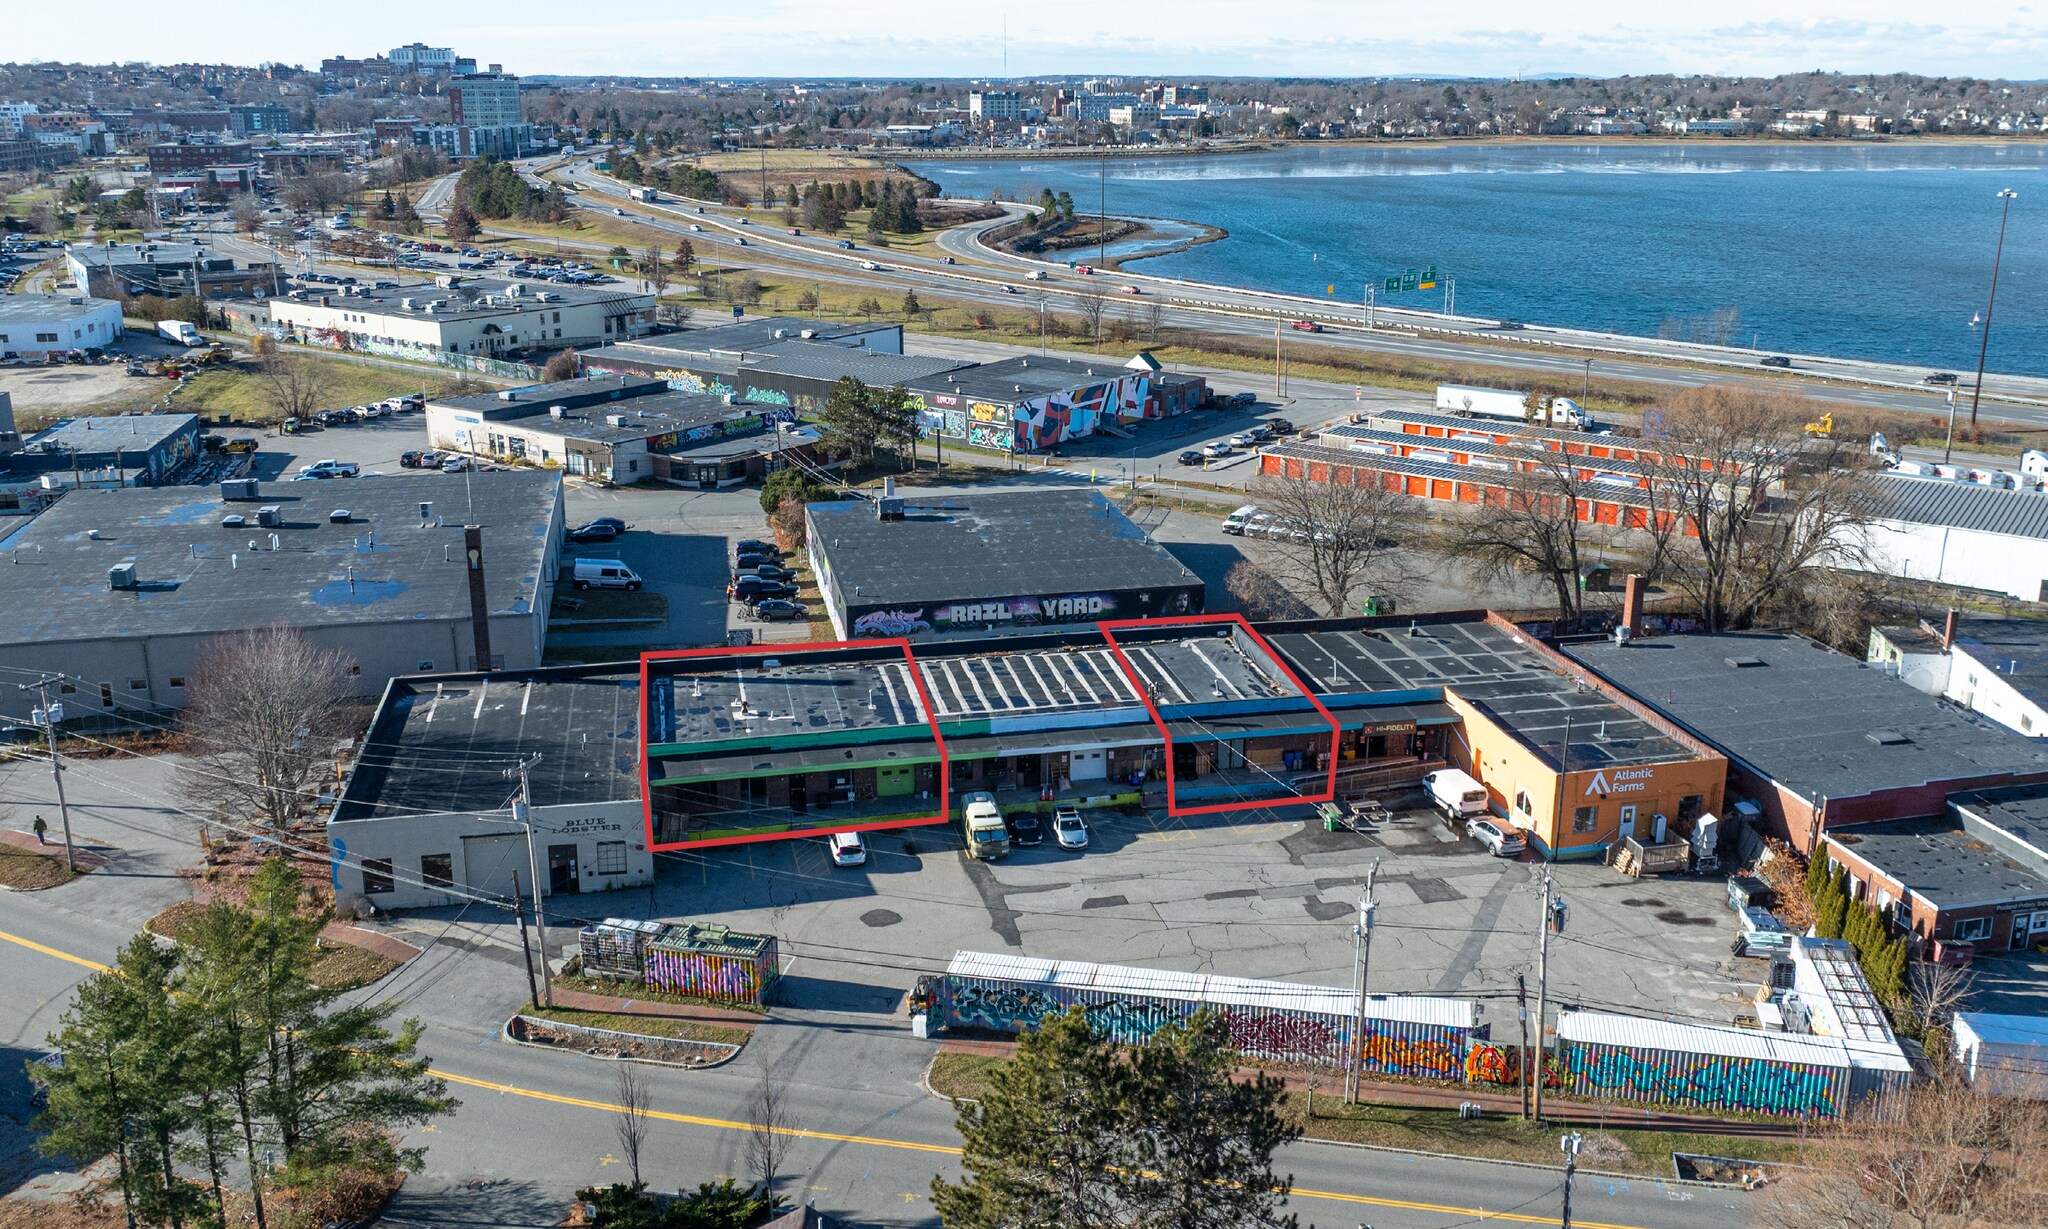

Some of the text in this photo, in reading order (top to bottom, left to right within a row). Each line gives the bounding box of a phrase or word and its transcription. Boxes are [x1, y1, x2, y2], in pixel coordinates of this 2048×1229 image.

[951, 602, 1013, 623] RAIL
[1043, 597, 1103, 618] YARD
[1376, 723, 1415, 732] HI-FIDELITY
[1613, 768, 1654, 781] Atlantic
[1612, 782, 1645, 793] Farms
[565, 818, 606, 827] BLUE
[552, 824, 621, 834] LOBSTER
